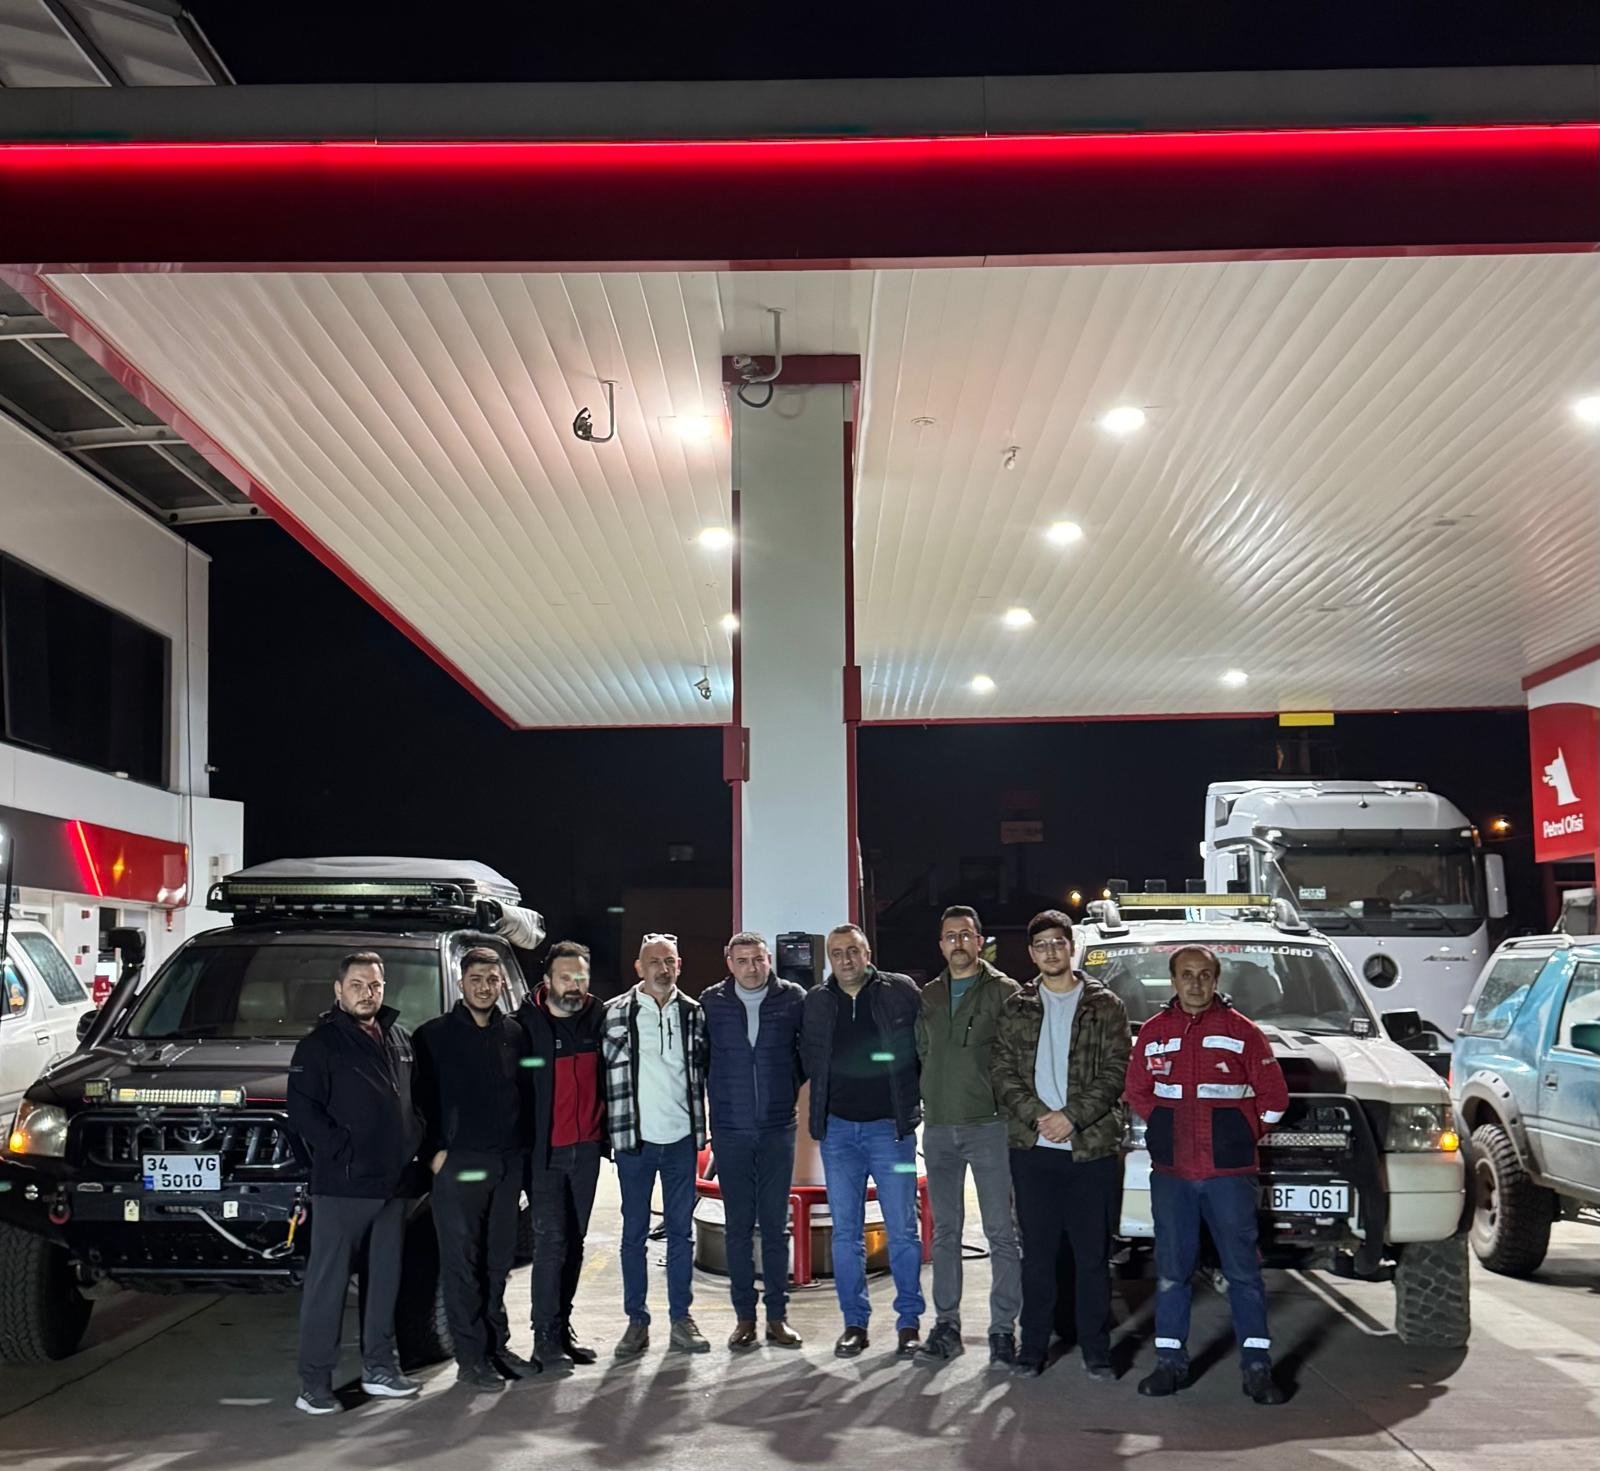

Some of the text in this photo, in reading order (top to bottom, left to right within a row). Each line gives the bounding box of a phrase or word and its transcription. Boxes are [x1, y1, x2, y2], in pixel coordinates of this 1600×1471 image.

[1543, 818, 1565, 839] Petrol
[1106, 946, 1150, 958] BOLU
[147, 1157, 217, 1172] 34 VG
[161, 1173, 203, 1188] 5010
[1309, 1189, 1342, 1210] 061
